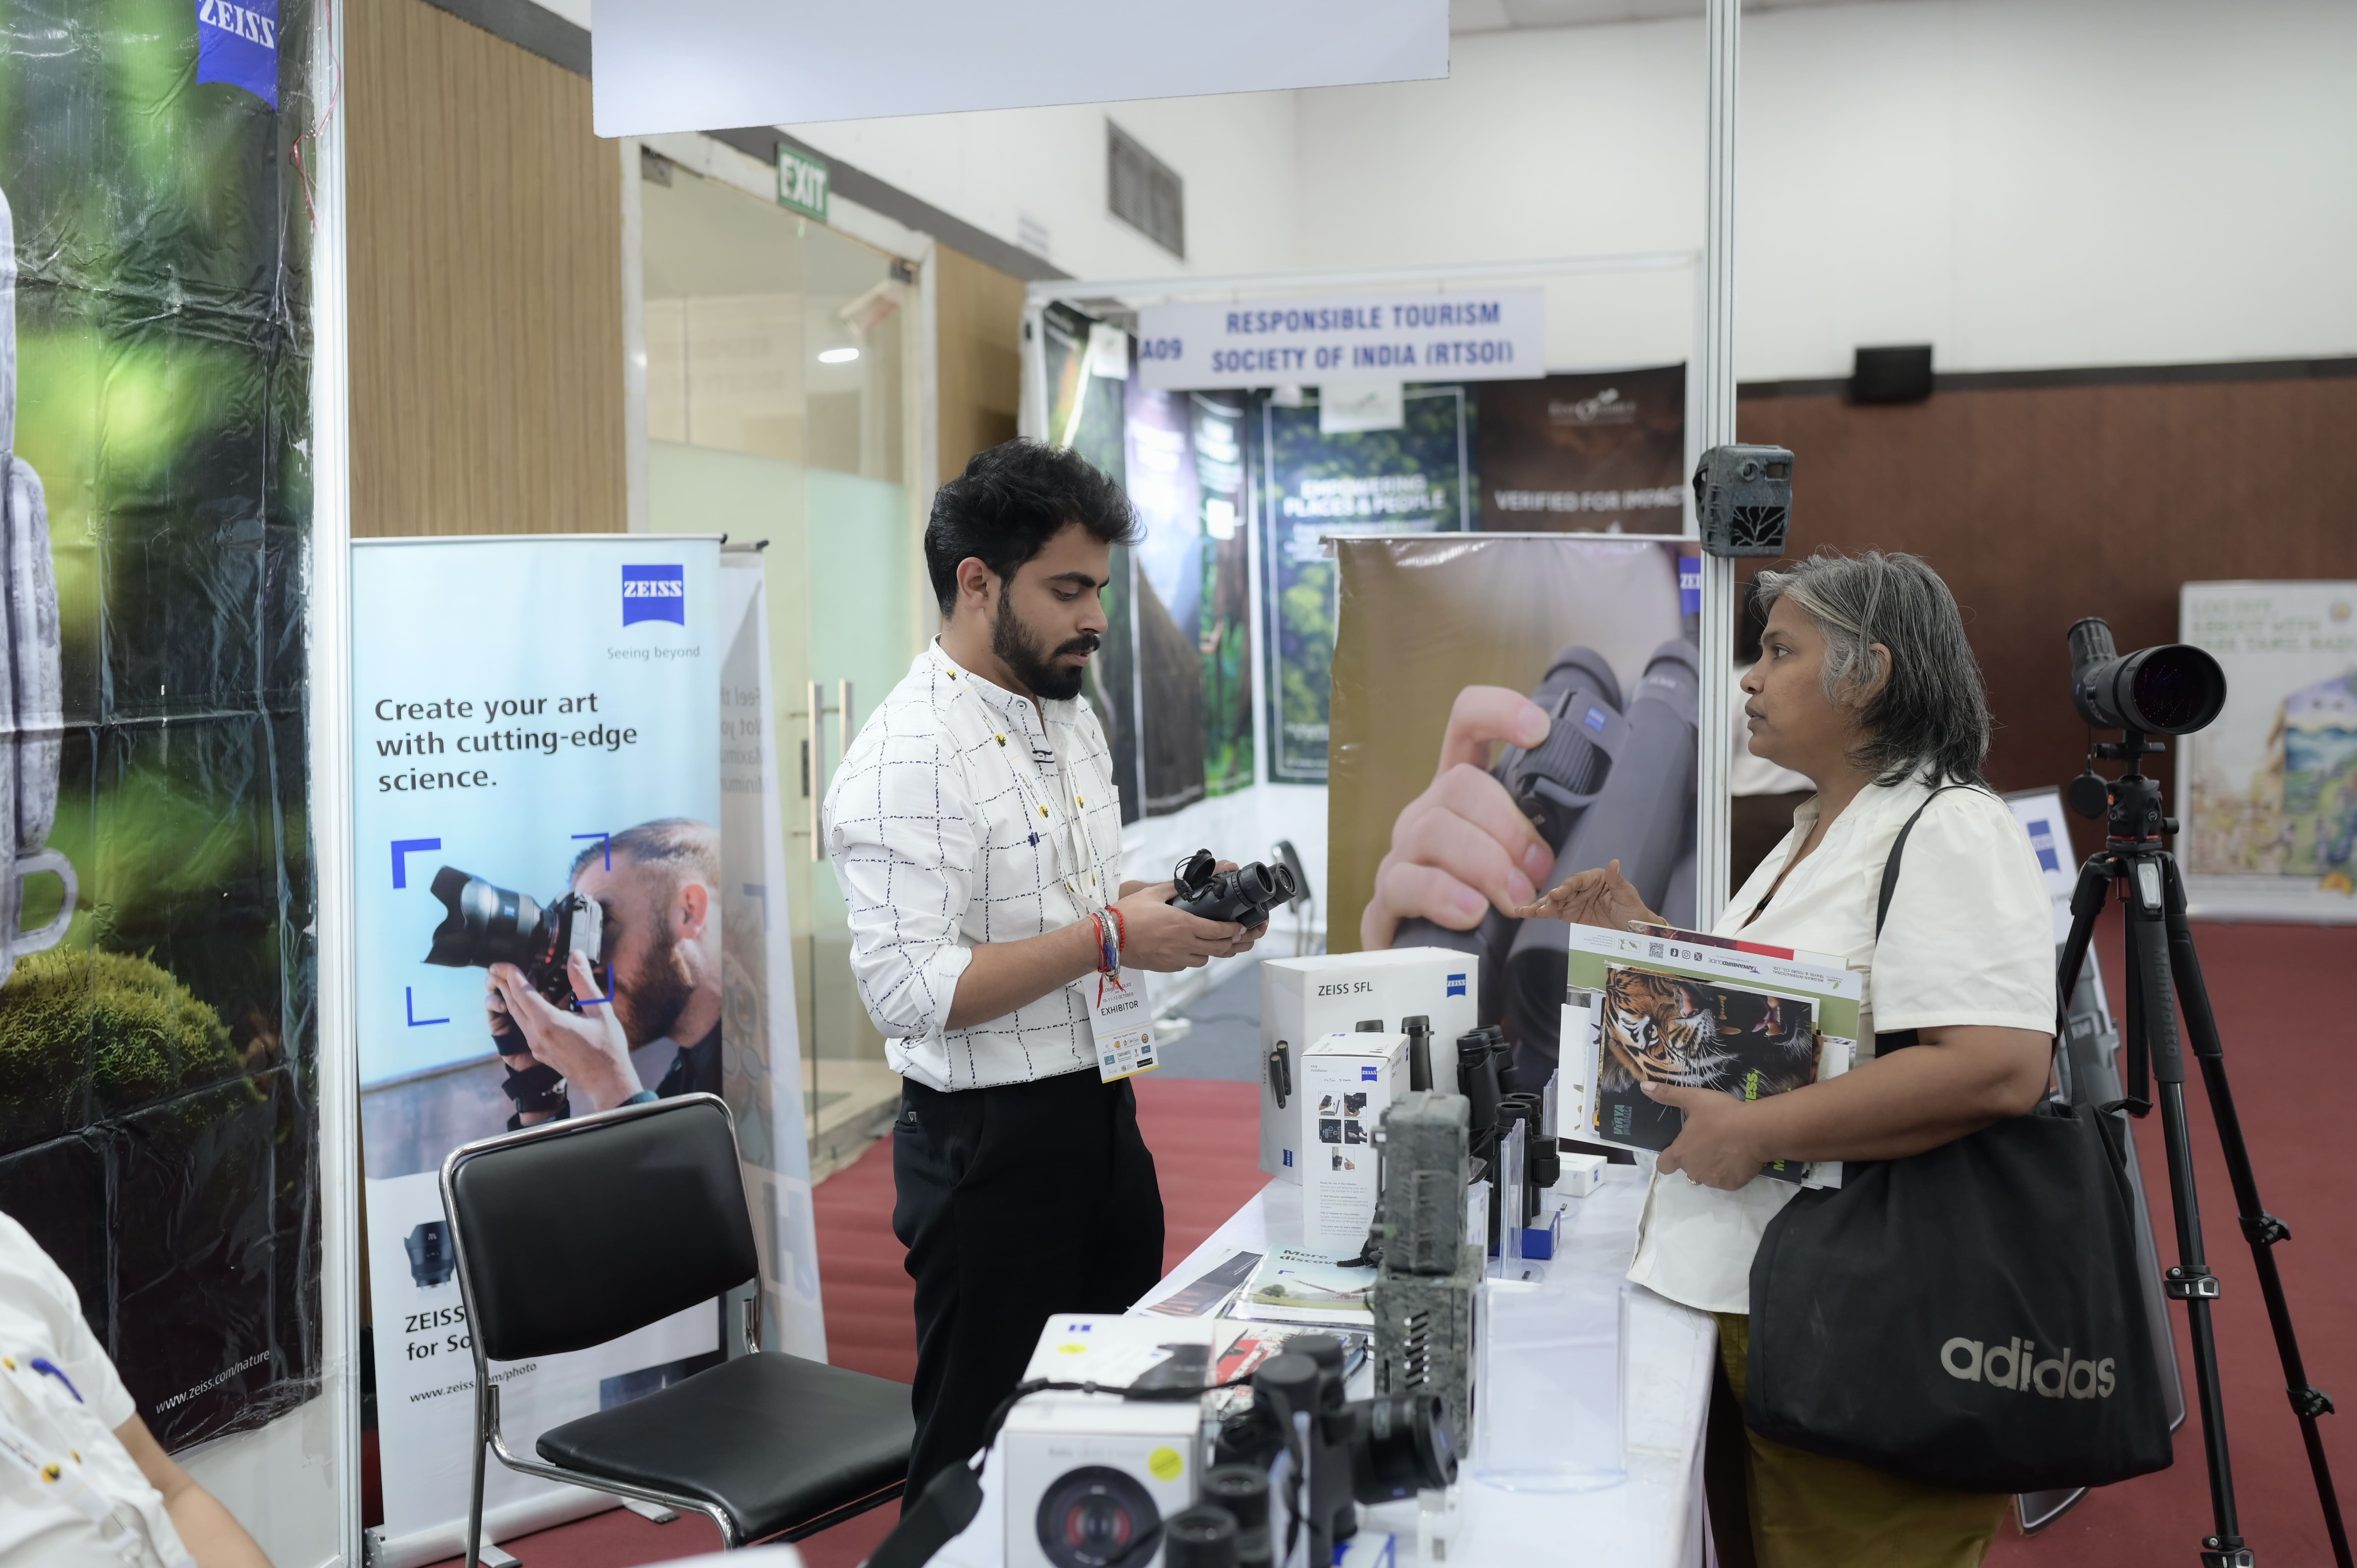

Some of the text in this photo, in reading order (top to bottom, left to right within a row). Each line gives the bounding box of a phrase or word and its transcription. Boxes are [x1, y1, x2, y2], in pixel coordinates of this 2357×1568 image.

[199, 0, 274, 49] ZEISS
[780, 153, 827, 212] EXIT
[1227, 302, 1500, 333] RESPONSIBLE TOURISM
[1141, 339, 1183, 360] A09
[1212, 347, 1305, 372] SOCIETY
[1315, 345, 1343, 368] OF
[1353, 343, 1416, 369] INDIA
[1494, 489, 1579, 512] VERIFIED
[1581, 490, 1620, 512] FOR
[624, 580, 682, 597] ZEISS
[1680, 573, 1700, 590] ZEI
[607, 645, 700, 662] Seeing beyond
[375, 692, 598, 724] Create your art
[376, 723, 638, 756] with cutting-edge
[379, 767, 497, 792] science.
[1018, 772, 1039, 805] GLOBAL WILDLIFE
[1447, 979, 1466, 987] ZEISS
[1773, 970, 1804, 979] INTERNATIONAL
[1318, 982, 1373, 996] ZEISS SFL
[1101, 1000, 1139, 1016] EXHIBITOR
[2154, 948, 2179, 1058] Manfrotto
[1279, 1254, 1338, 1265] discov
[1283, 1249, 1328, 1260] More
[405, 1305, 465, 1333] ZEISS
[406, 1334, 471, 1361] for So
[1940, 1336, 2115, 1400] adidas
[156, 1349, 270, 1414] www.zeiss.com/nature
